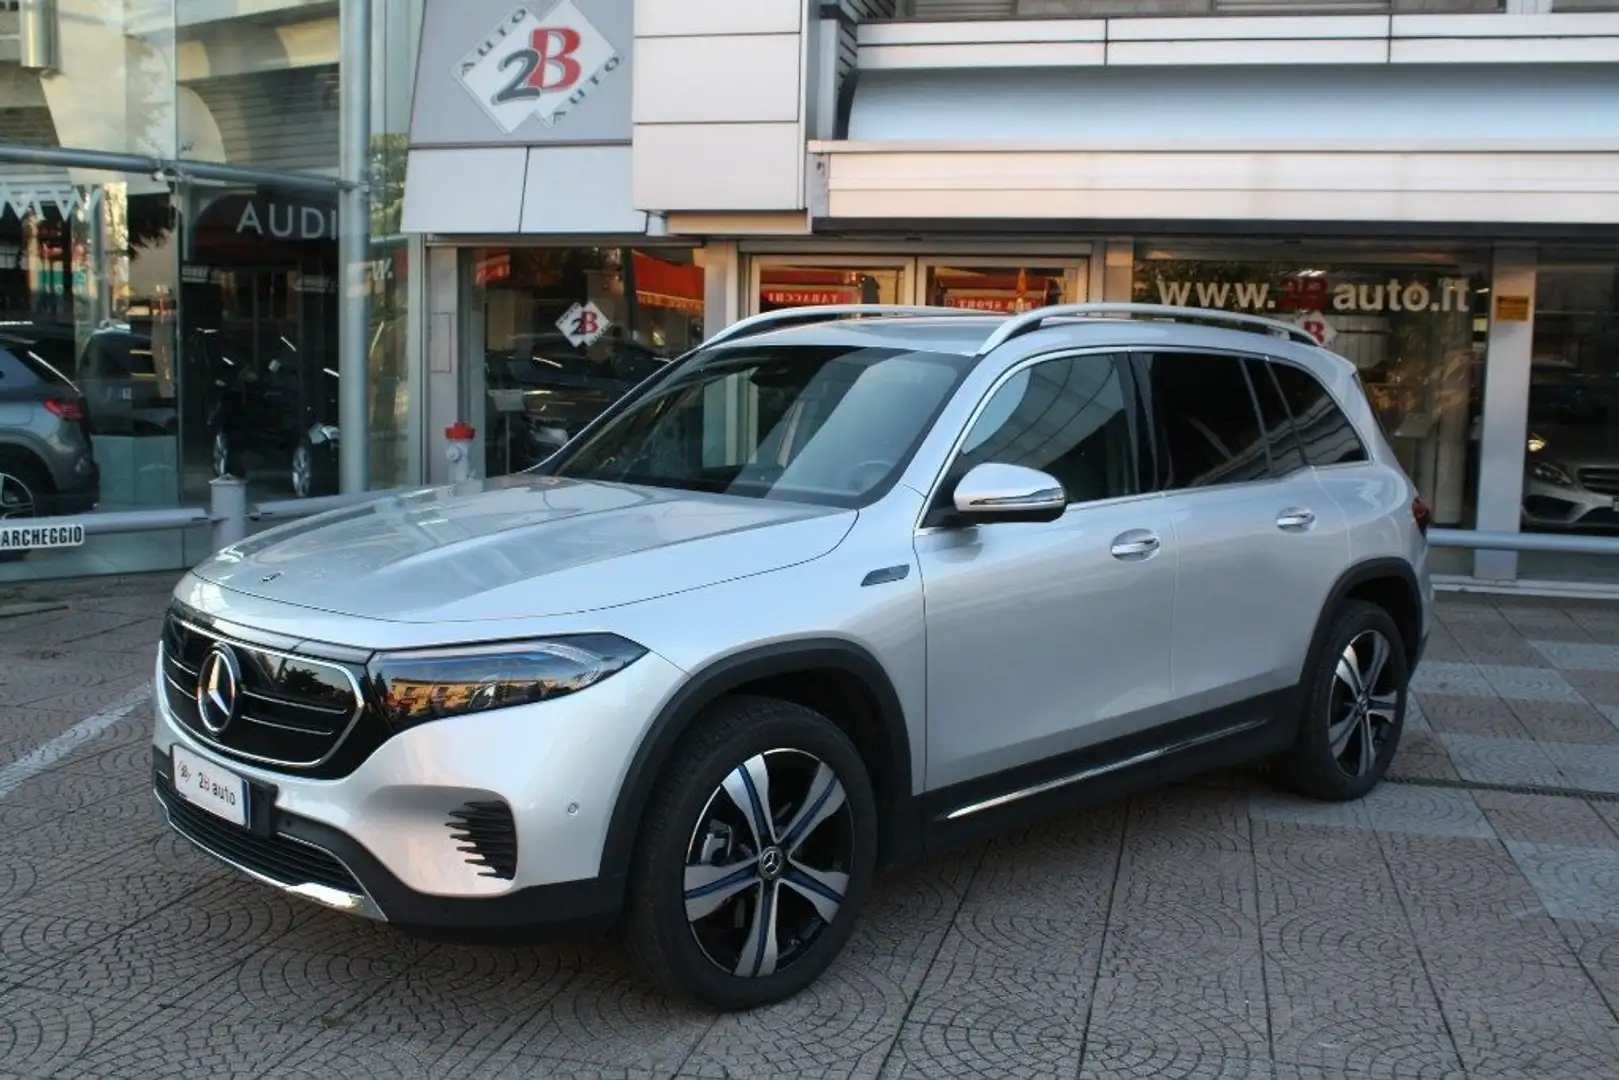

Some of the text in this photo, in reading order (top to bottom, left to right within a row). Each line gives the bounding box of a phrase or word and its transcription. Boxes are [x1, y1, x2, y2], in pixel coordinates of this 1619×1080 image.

[460, 8, 527, 77] AUTO
[491, 27, 582, 106] 2B
[552, 56, 621, 125] AUTO
[236, 201, 338, 241] AUDI
[569, 311, 598, 335] 2B
[1, 526, 82, 546] ARCHEGGIO
